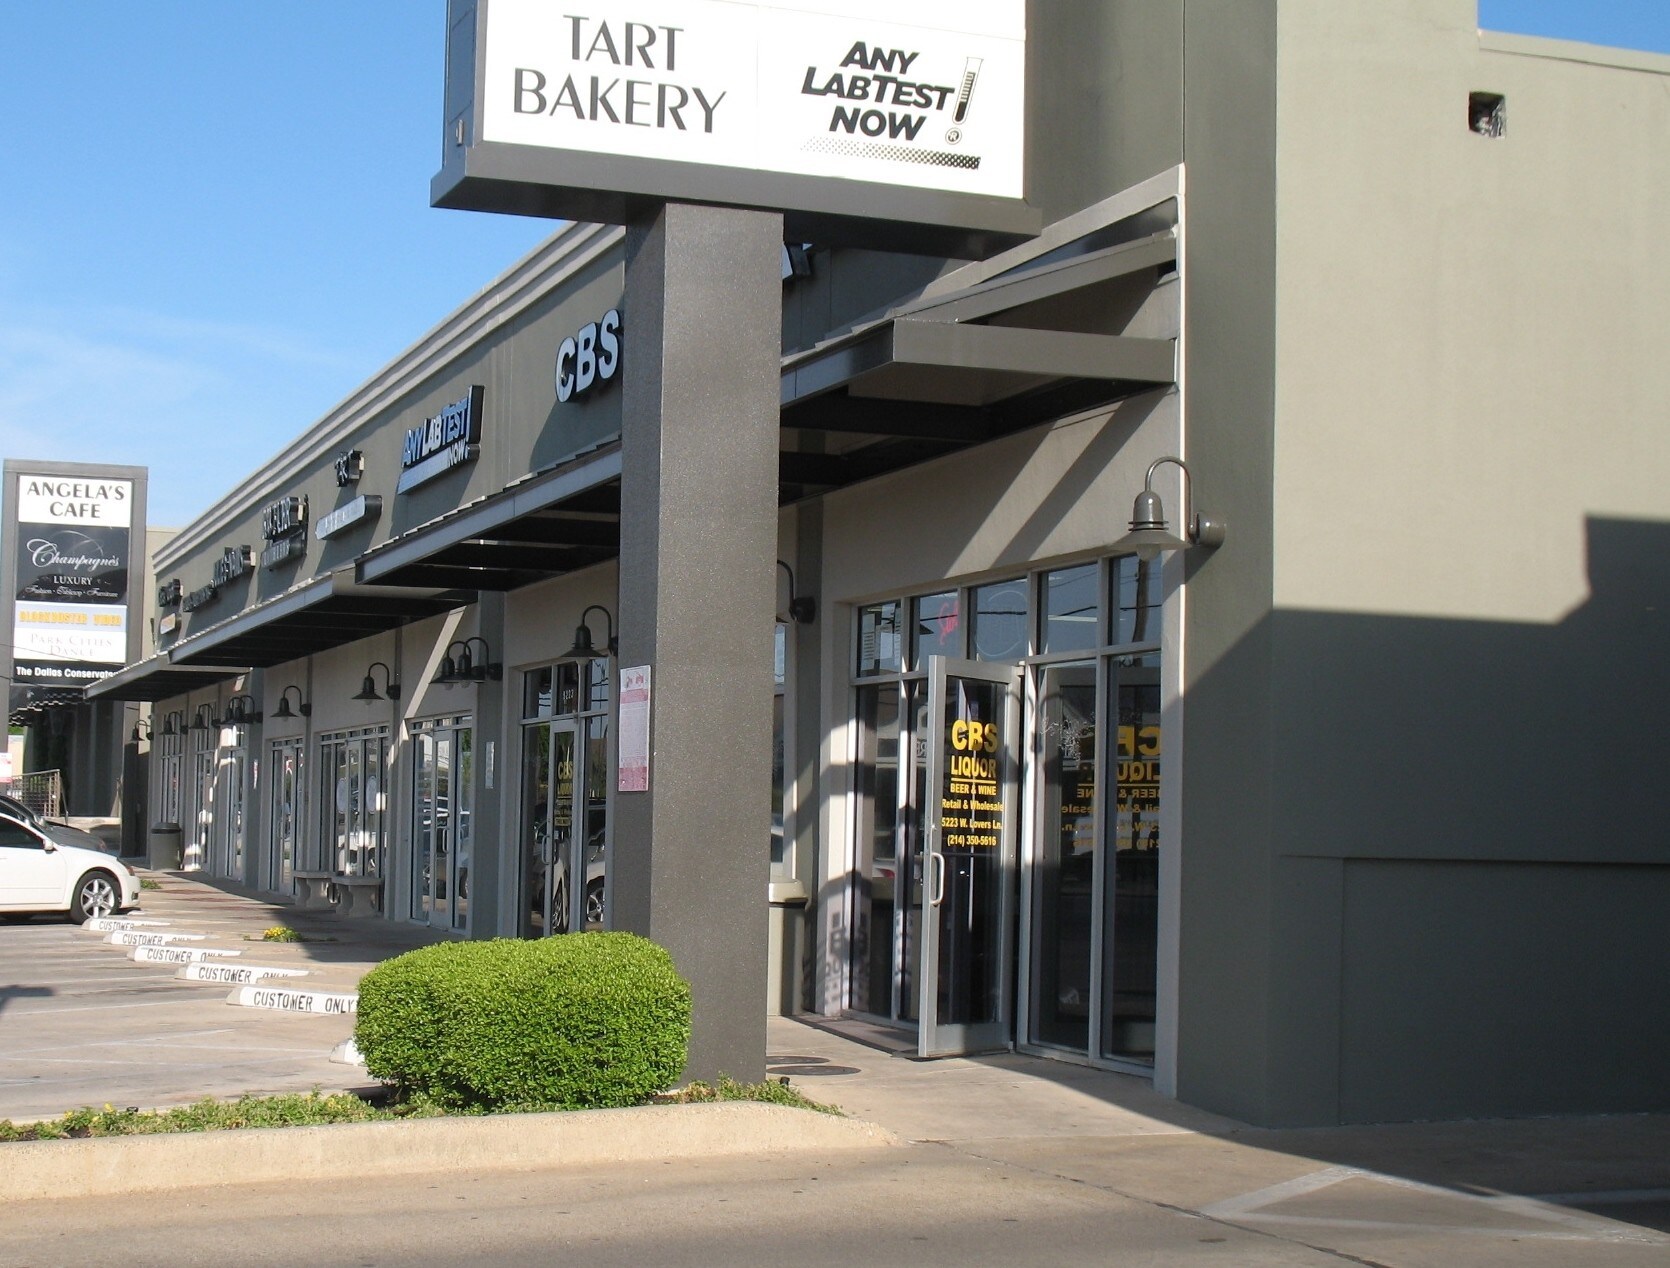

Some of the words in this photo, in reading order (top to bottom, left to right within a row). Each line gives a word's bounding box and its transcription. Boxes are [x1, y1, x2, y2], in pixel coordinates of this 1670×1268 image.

[563, 14, 685, 72] TART
[839, 40, 920, 76] ANY
[801, 65, 956, 111] LABTEST
[514, 67, 727, 134] BAKERY
[829, 105, 927, 141] NOW
[556, 309, 620, 403] CBS
[27, 481, 125, 500] ANGELA'S
[50, 501, 101, 518] CAFE
[53, 576, 93, 585] LUXURY
[16, 667, 33, 676] The
[35, 668, 62, 678] Dallas
[952, 719, 998, 753] CBS
[951, 755, 997, 778] LIQUOR
[950, 783, 970, 794] BEER
[970, 784, 977, 795] &
[977, 785, 997, 796] WINE
[942, 799, 962, 809] Retail
[962, 799, 969, 810] &
[970, 800, 1004, 812] Wholesale
[941, 817, 959, 828] 5223
[960, 818, 968, 828] W.
[969, 819, 992, 829] Lovers
[947, 835, 965, 847] (214)
[99, 920, 135, 932] CUSTOMER
[122, 933, 163, 945] CUSTOMER
[147, 948, 192, 962] CUSTOMER
[198, 966, 252, 983] CUSTOMER
[253, 991, 313, 1012] CUSTOMER
[325, 998, 355, 1014] ONLY
